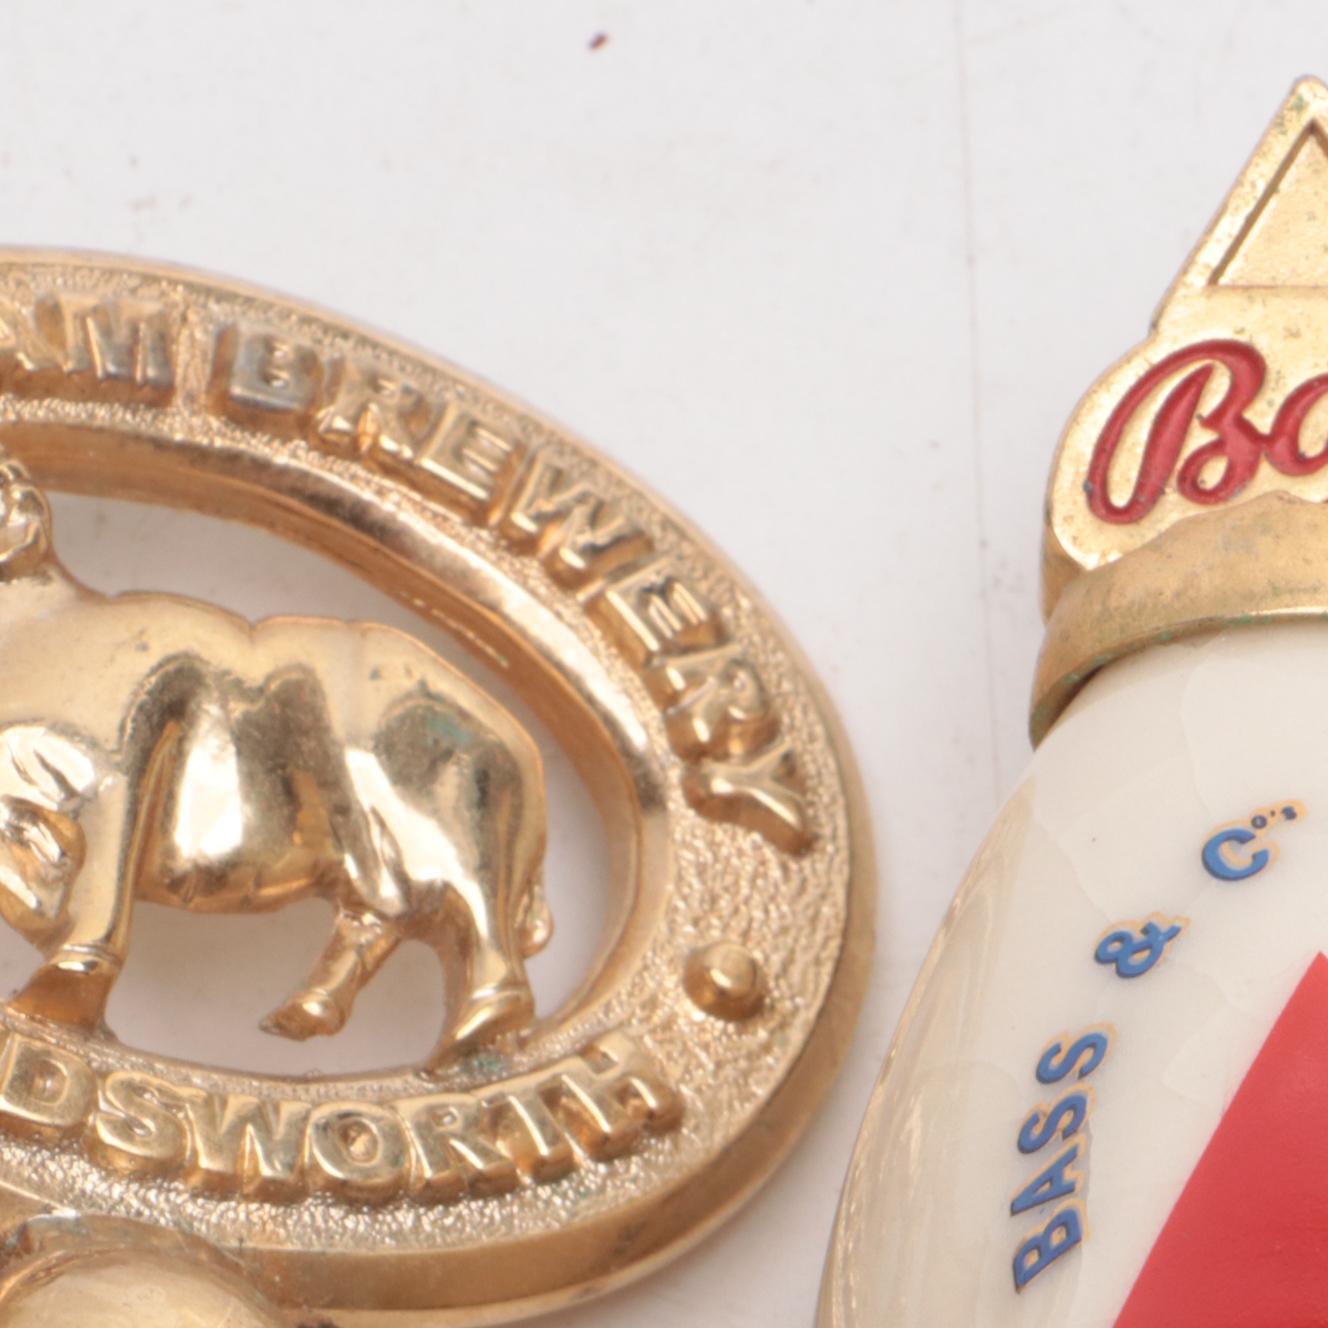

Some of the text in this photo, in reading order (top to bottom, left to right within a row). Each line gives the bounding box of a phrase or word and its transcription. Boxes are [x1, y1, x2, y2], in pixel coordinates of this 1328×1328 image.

[211, 318, 808, 853] BREWERY
[1009, 1020, 1118, 1294] BASS
[1093, 911, 1190, 980] &
